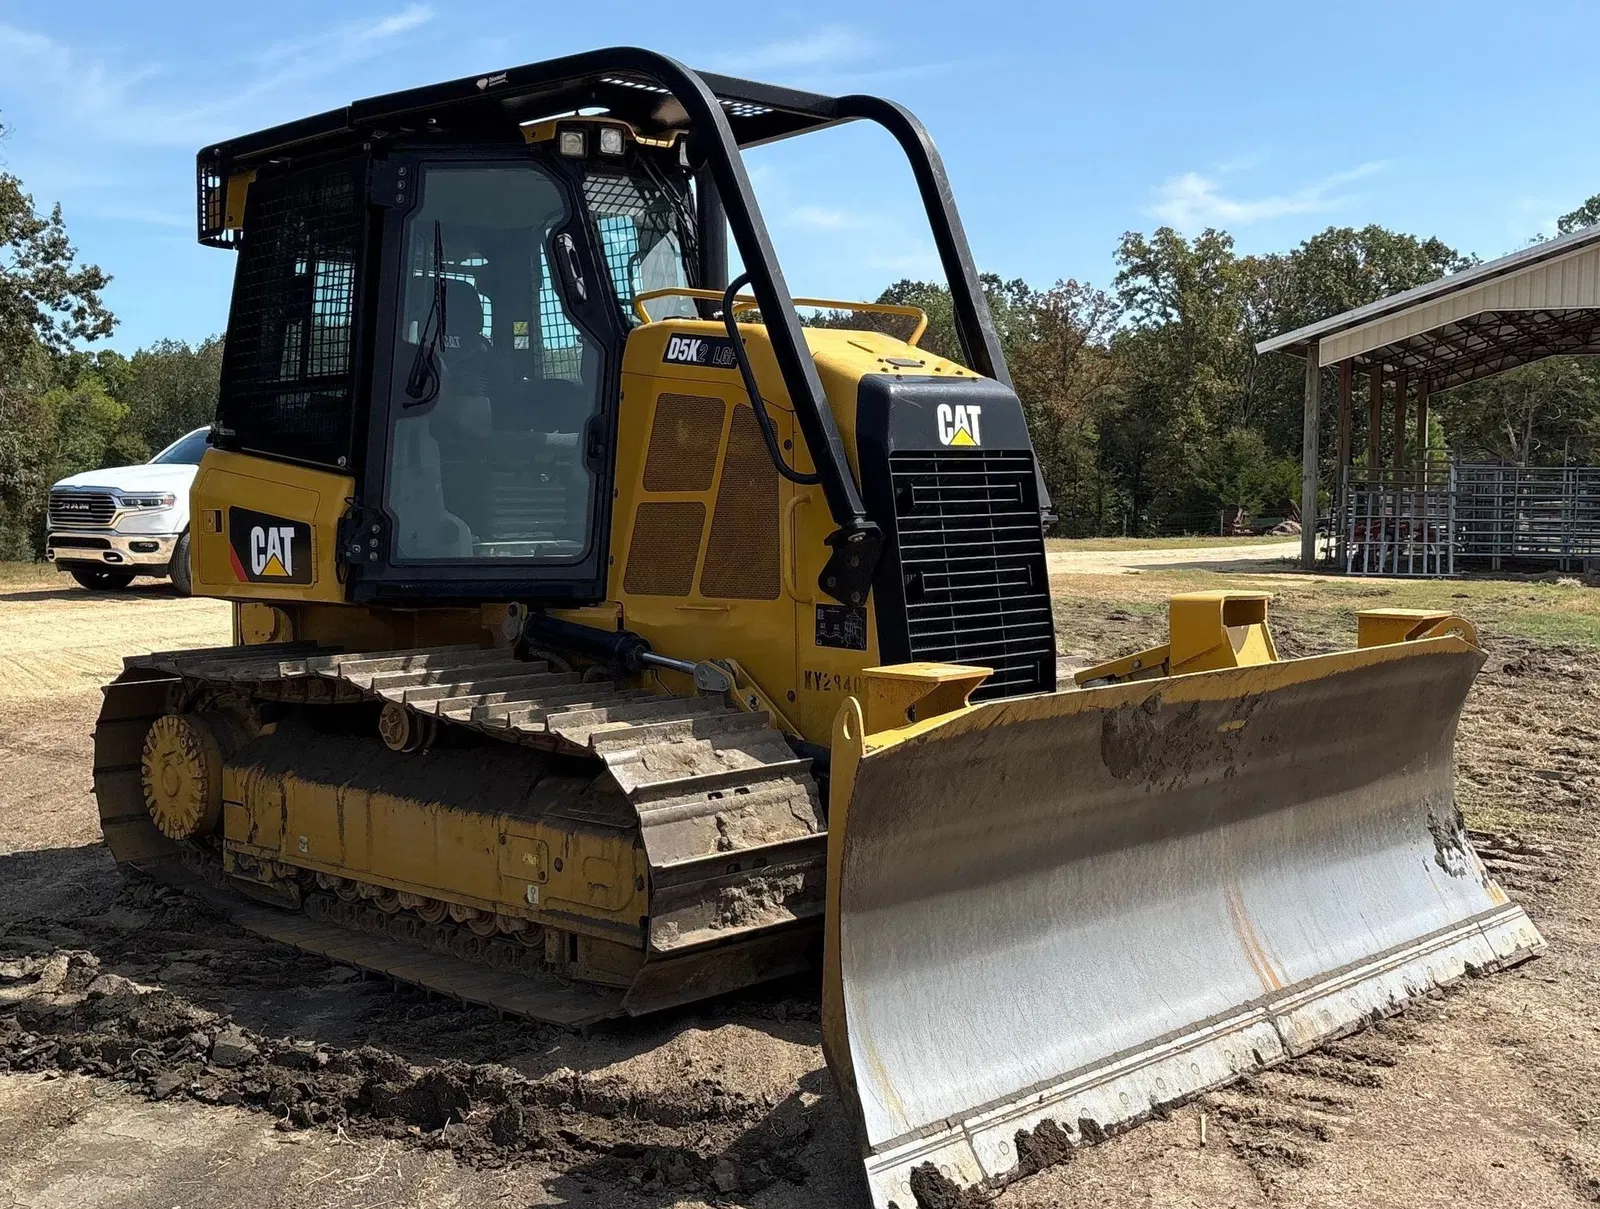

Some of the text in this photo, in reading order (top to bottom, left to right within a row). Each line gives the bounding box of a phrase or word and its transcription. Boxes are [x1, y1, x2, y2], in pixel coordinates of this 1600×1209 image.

[936, 403, 982, 446] CAT
[62, 502, 90, 510] RAM
[250, 526, 295, 576] CAT
